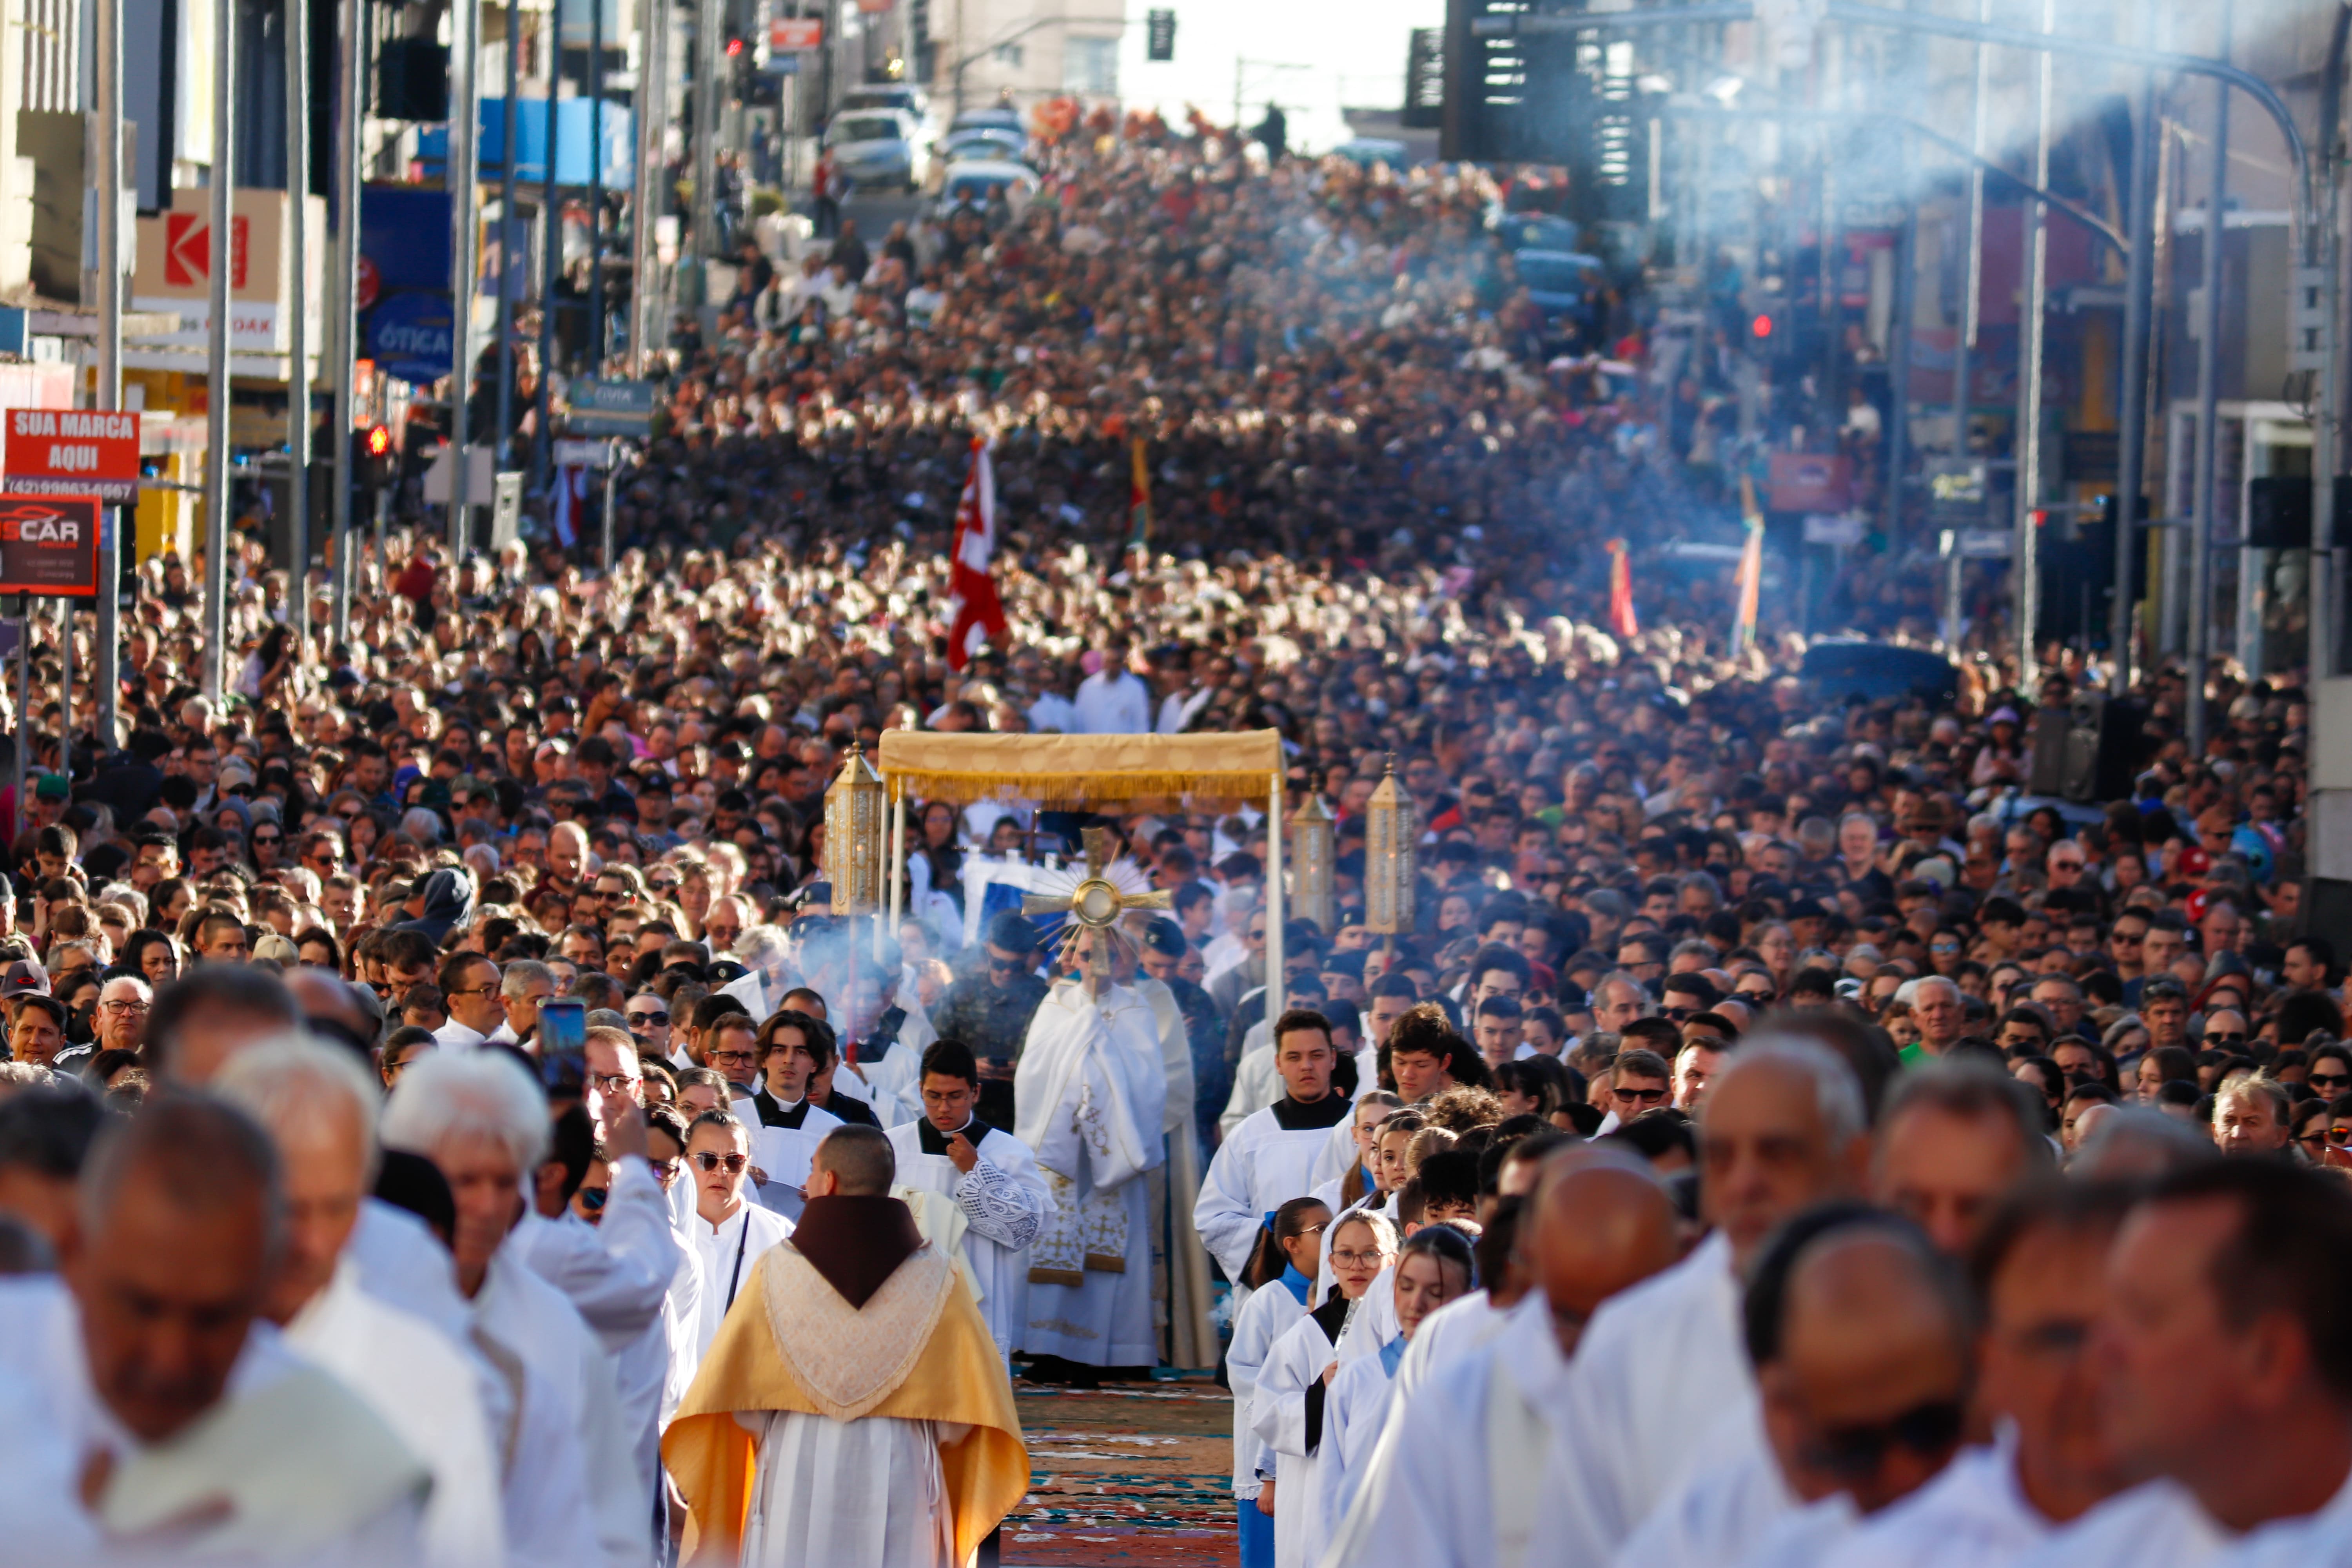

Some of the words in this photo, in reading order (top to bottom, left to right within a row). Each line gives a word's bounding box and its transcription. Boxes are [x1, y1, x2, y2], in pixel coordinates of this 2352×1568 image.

[378, 321, 449, 354] ÓTICA
[15, 411, 56, 436] SUA
[60, 413, 133, 439] MARCA
[48, 445, 98, 472] AQUI
